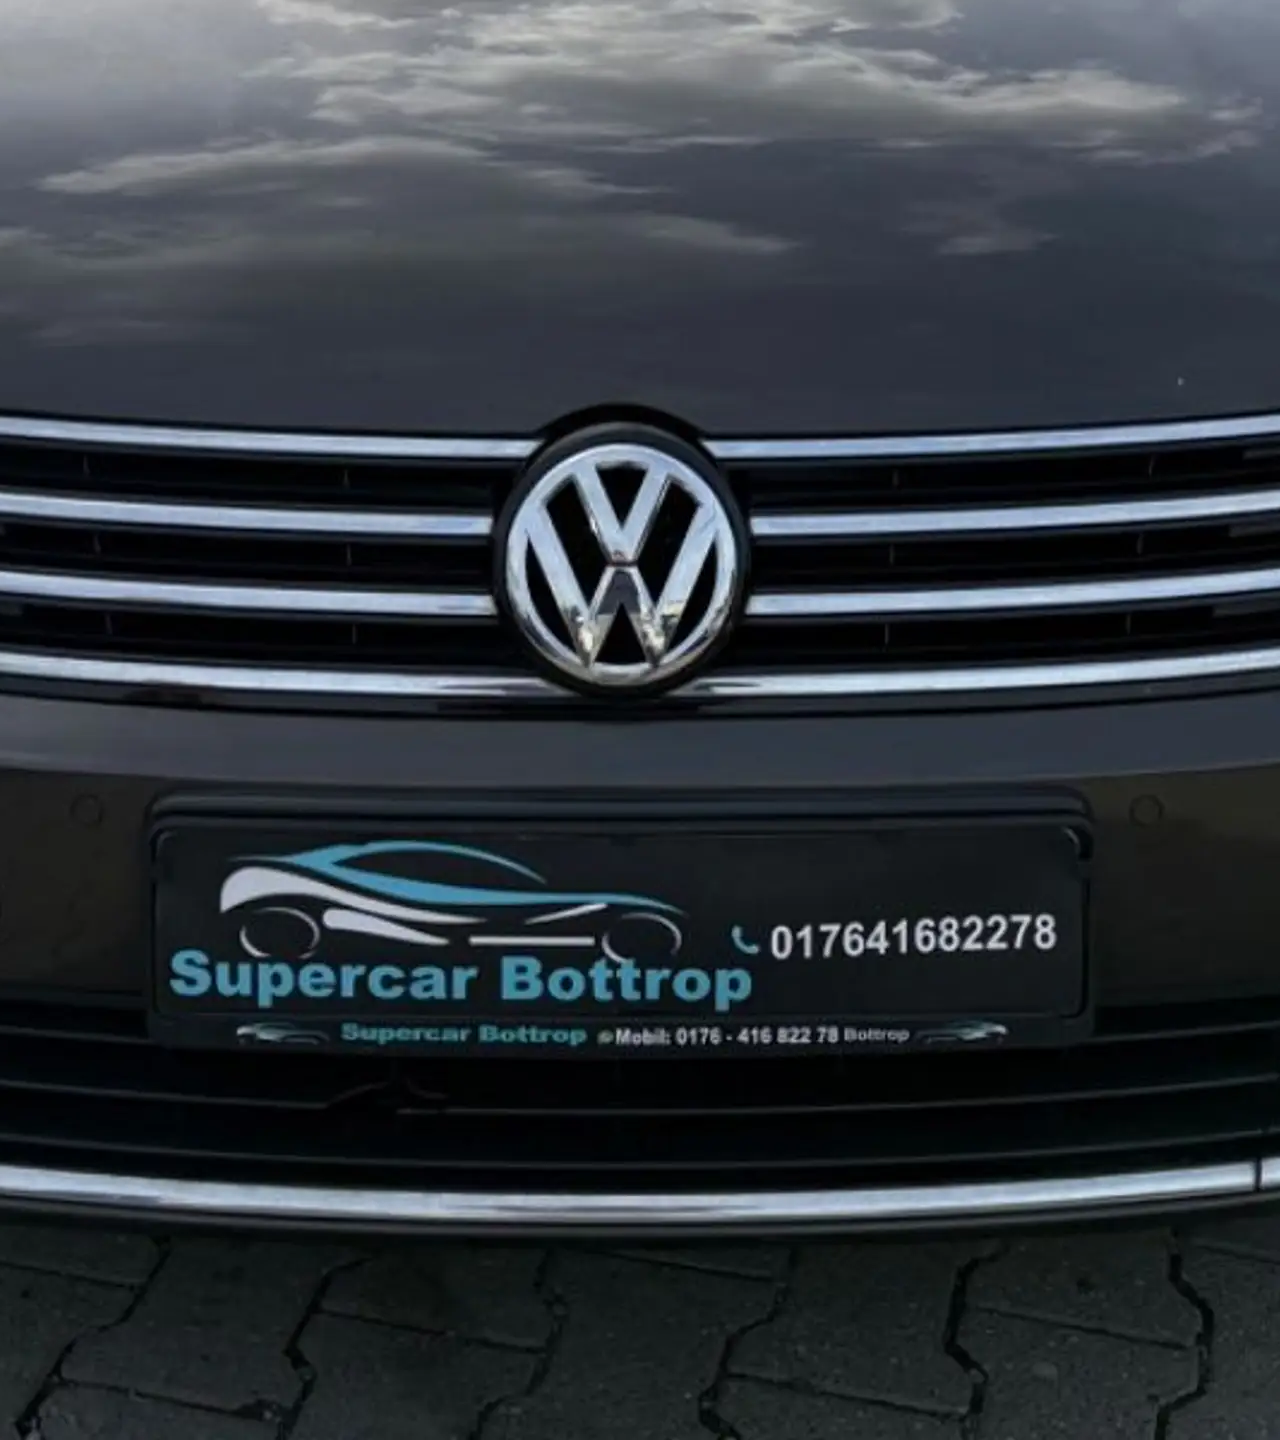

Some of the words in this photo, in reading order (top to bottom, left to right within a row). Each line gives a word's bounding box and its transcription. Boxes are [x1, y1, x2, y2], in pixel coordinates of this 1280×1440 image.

[770, 913, 1057, 960] 017641682278
[170, 949, 479, 1008] Supercar
[501, 955, 752, 1011] Bottrop
[340, 1022, 471, 1044] Supercar
[479, 1024, 587, 1046] Bottrop
[615, 1027, 671, 1045] Mobil:
[675, 1027, 720, 1045] 0176
[737, 1027, 772, 1044] 416
[777, 1027, 811, 1044] 822
[817, 1026, 839, 1044] 78
[844, 1027, 910, 1043] Bottrop
